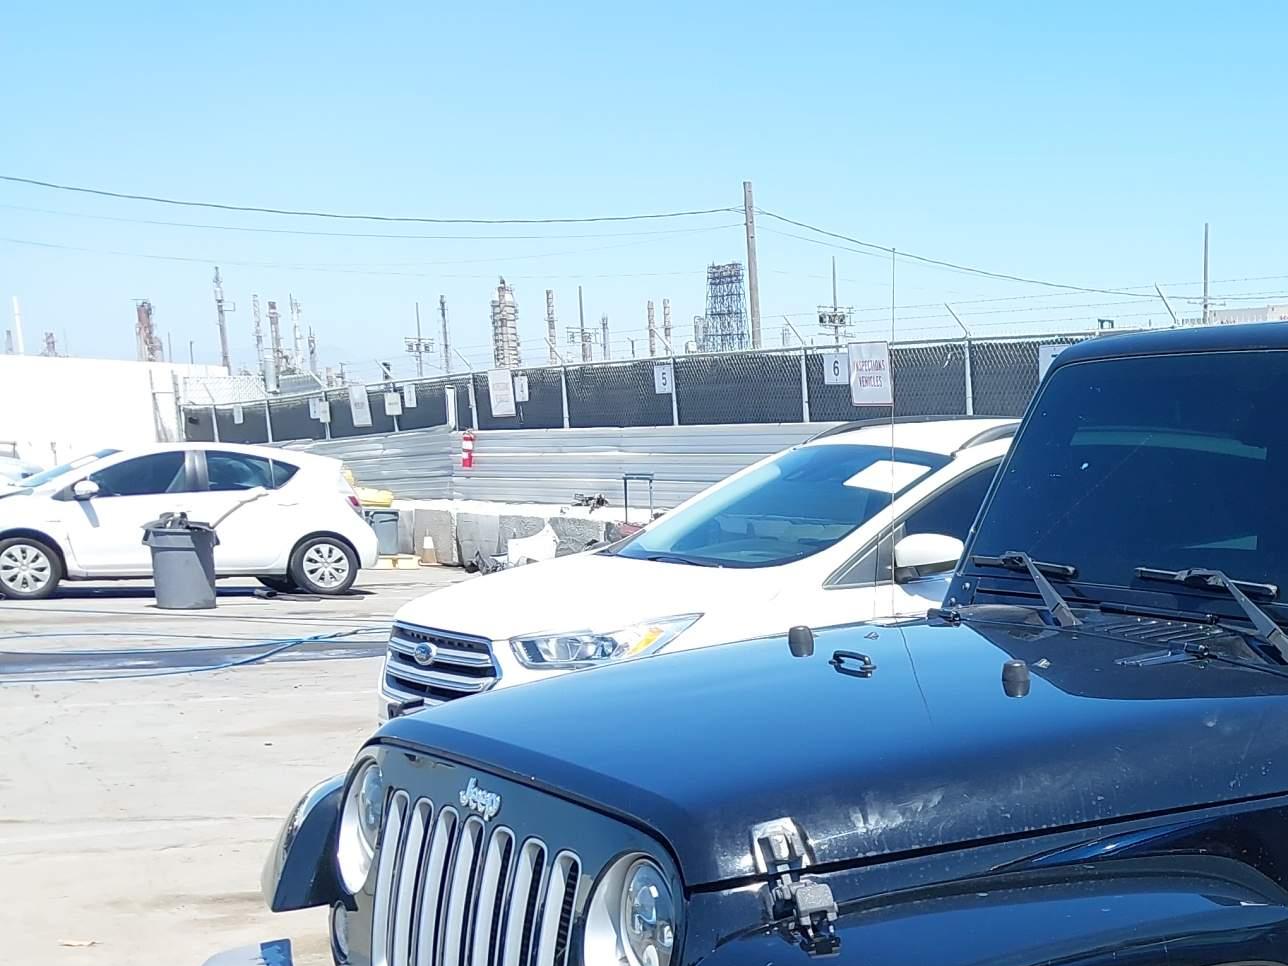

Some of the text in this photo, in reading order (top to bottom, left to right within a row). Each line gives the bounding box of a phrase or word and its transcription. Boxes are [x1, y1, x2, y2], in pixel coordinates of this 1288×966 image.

[832, 359, 841, 377] 6
[661, 371, 668, 387] 5
[459, 777, 501, 822] Jeep
